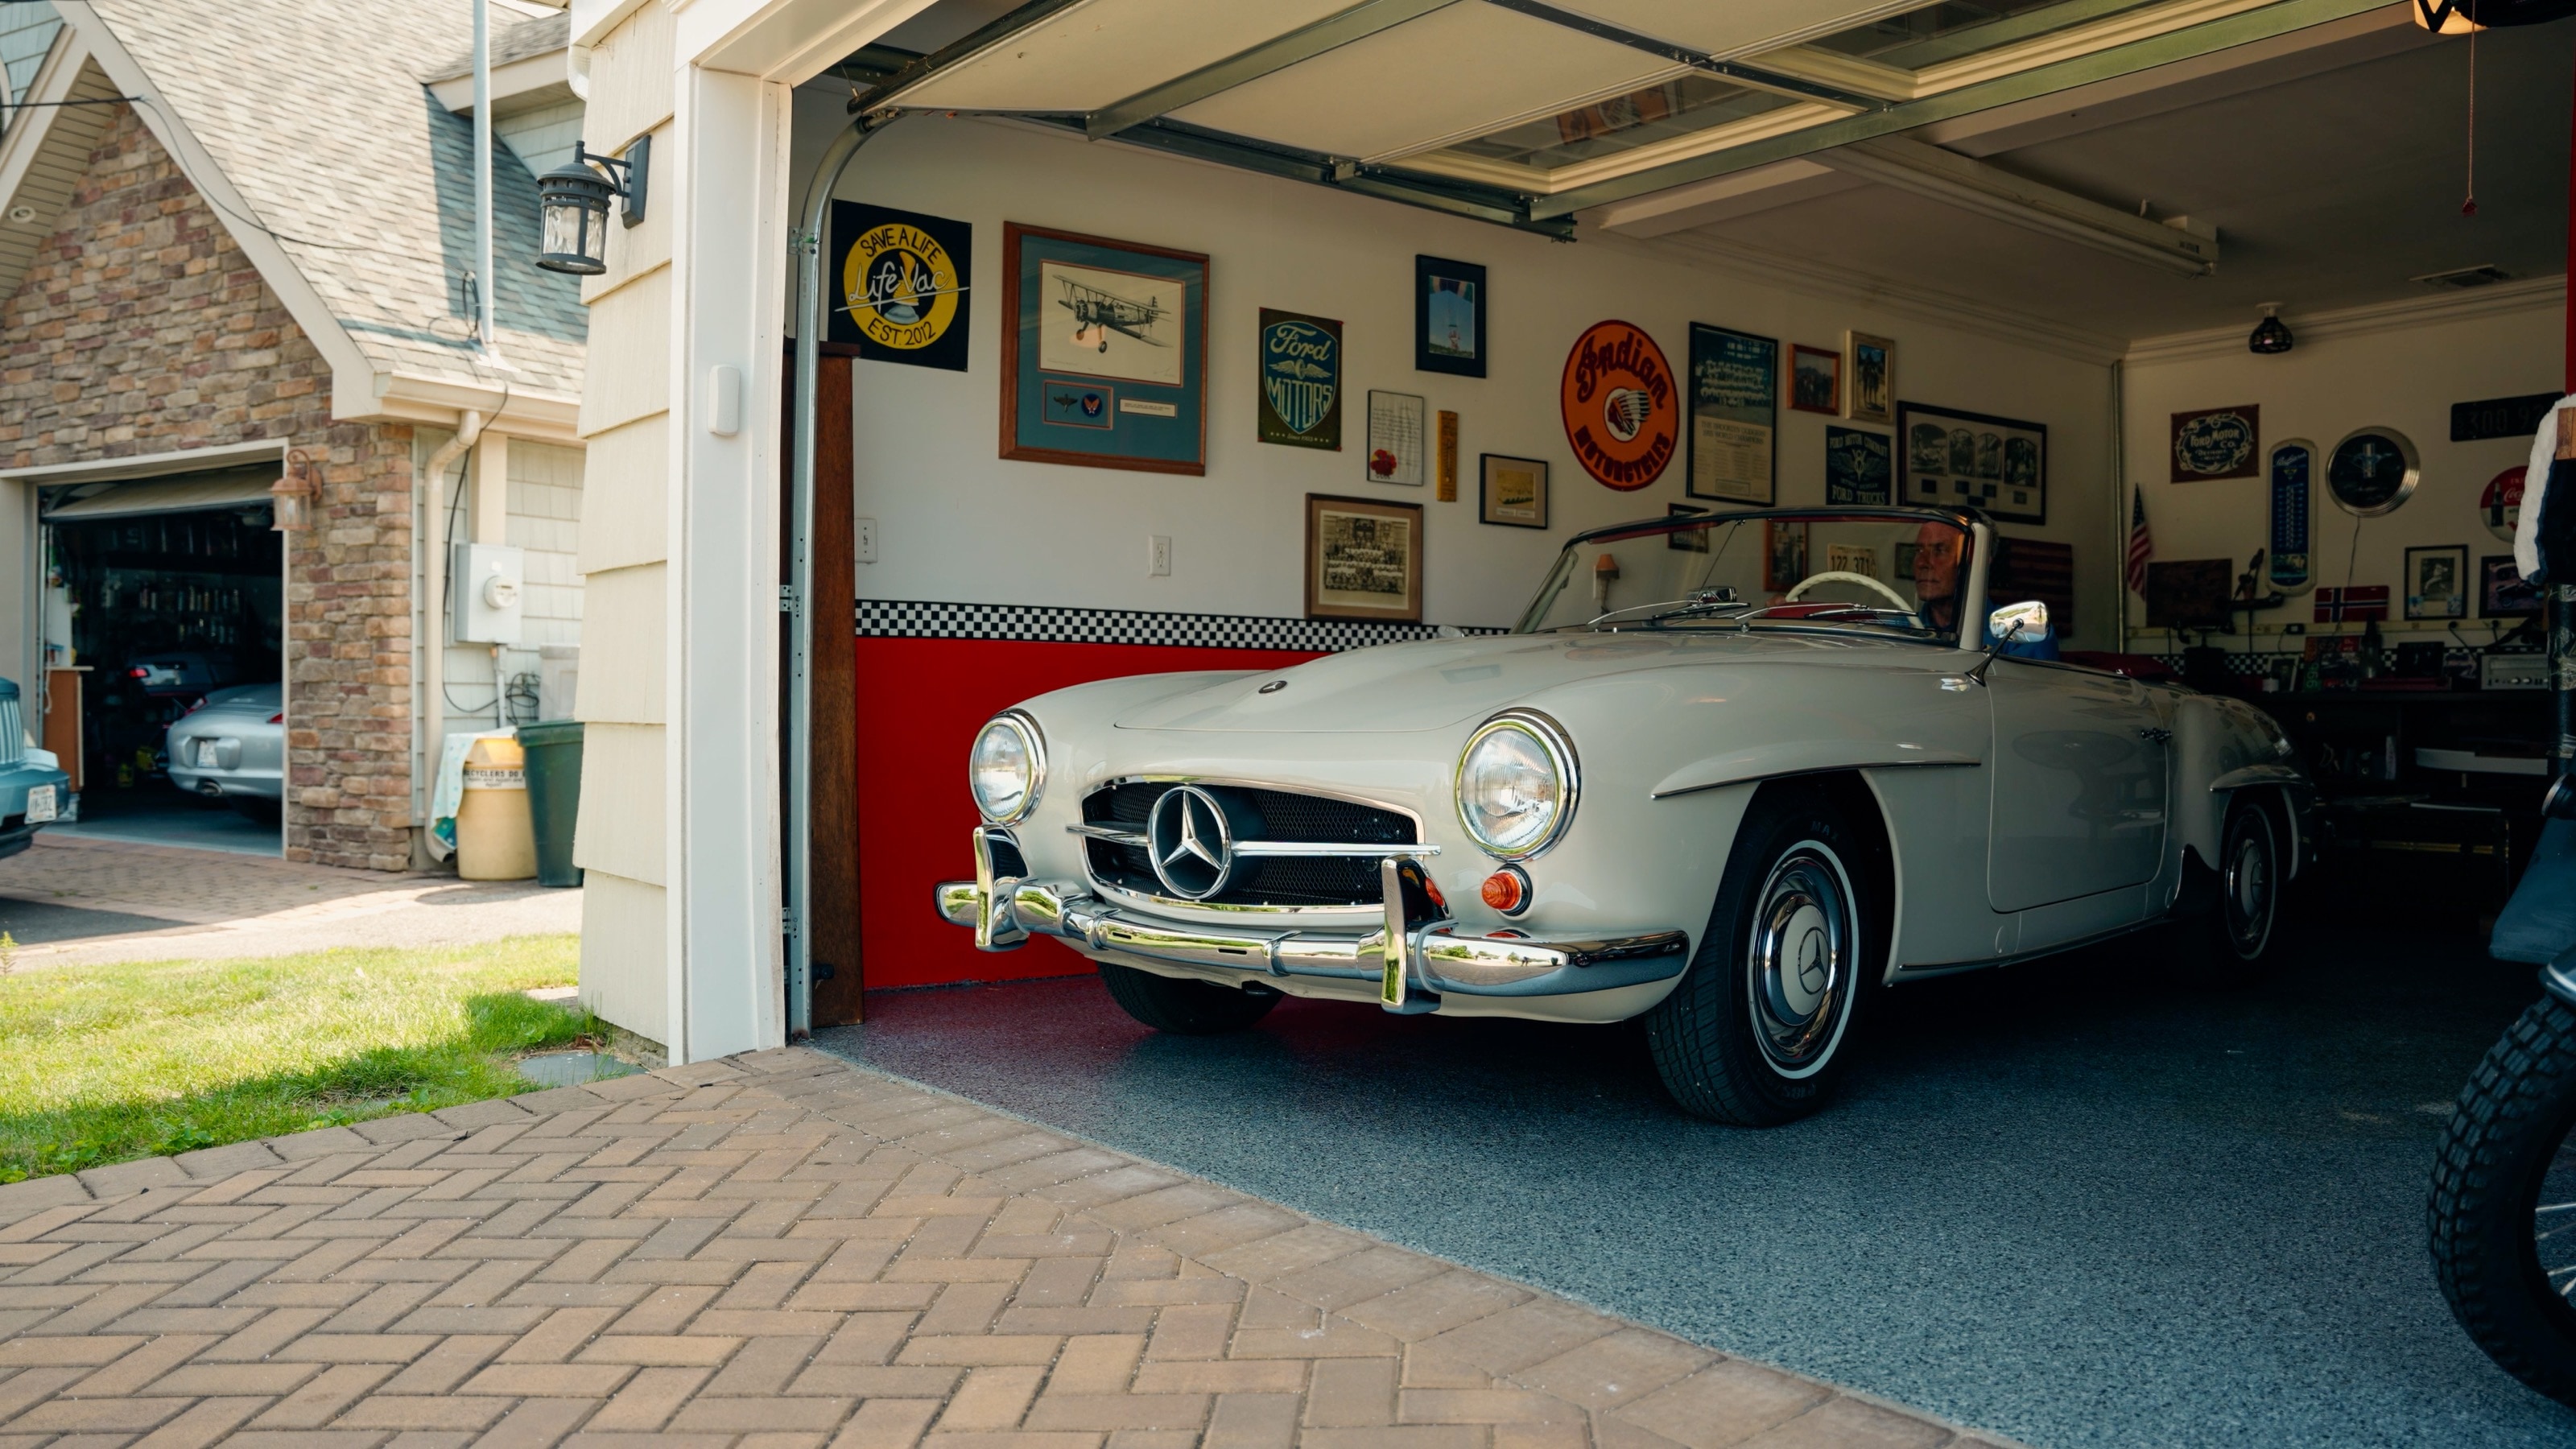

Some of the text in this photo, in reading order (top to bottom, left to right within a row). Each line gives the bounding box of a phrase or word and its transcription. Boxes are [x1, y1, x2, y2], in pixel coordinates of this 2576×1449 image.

[861, 227, 941, 265] SAVE A LIFE
[904, 321, 935, 345] 2012
[1270, 325, 1332, 361] Ford
[1575, 332, 1668, 410] Indian
[1267, 376, 1333, 428] MOTORS
[2211, 428, 2240, 441] MOTOR
[1574, 425, 1670, 483] MOTORCYCLES
[1831, 485, 1886, 506] FORD TRUCKS
